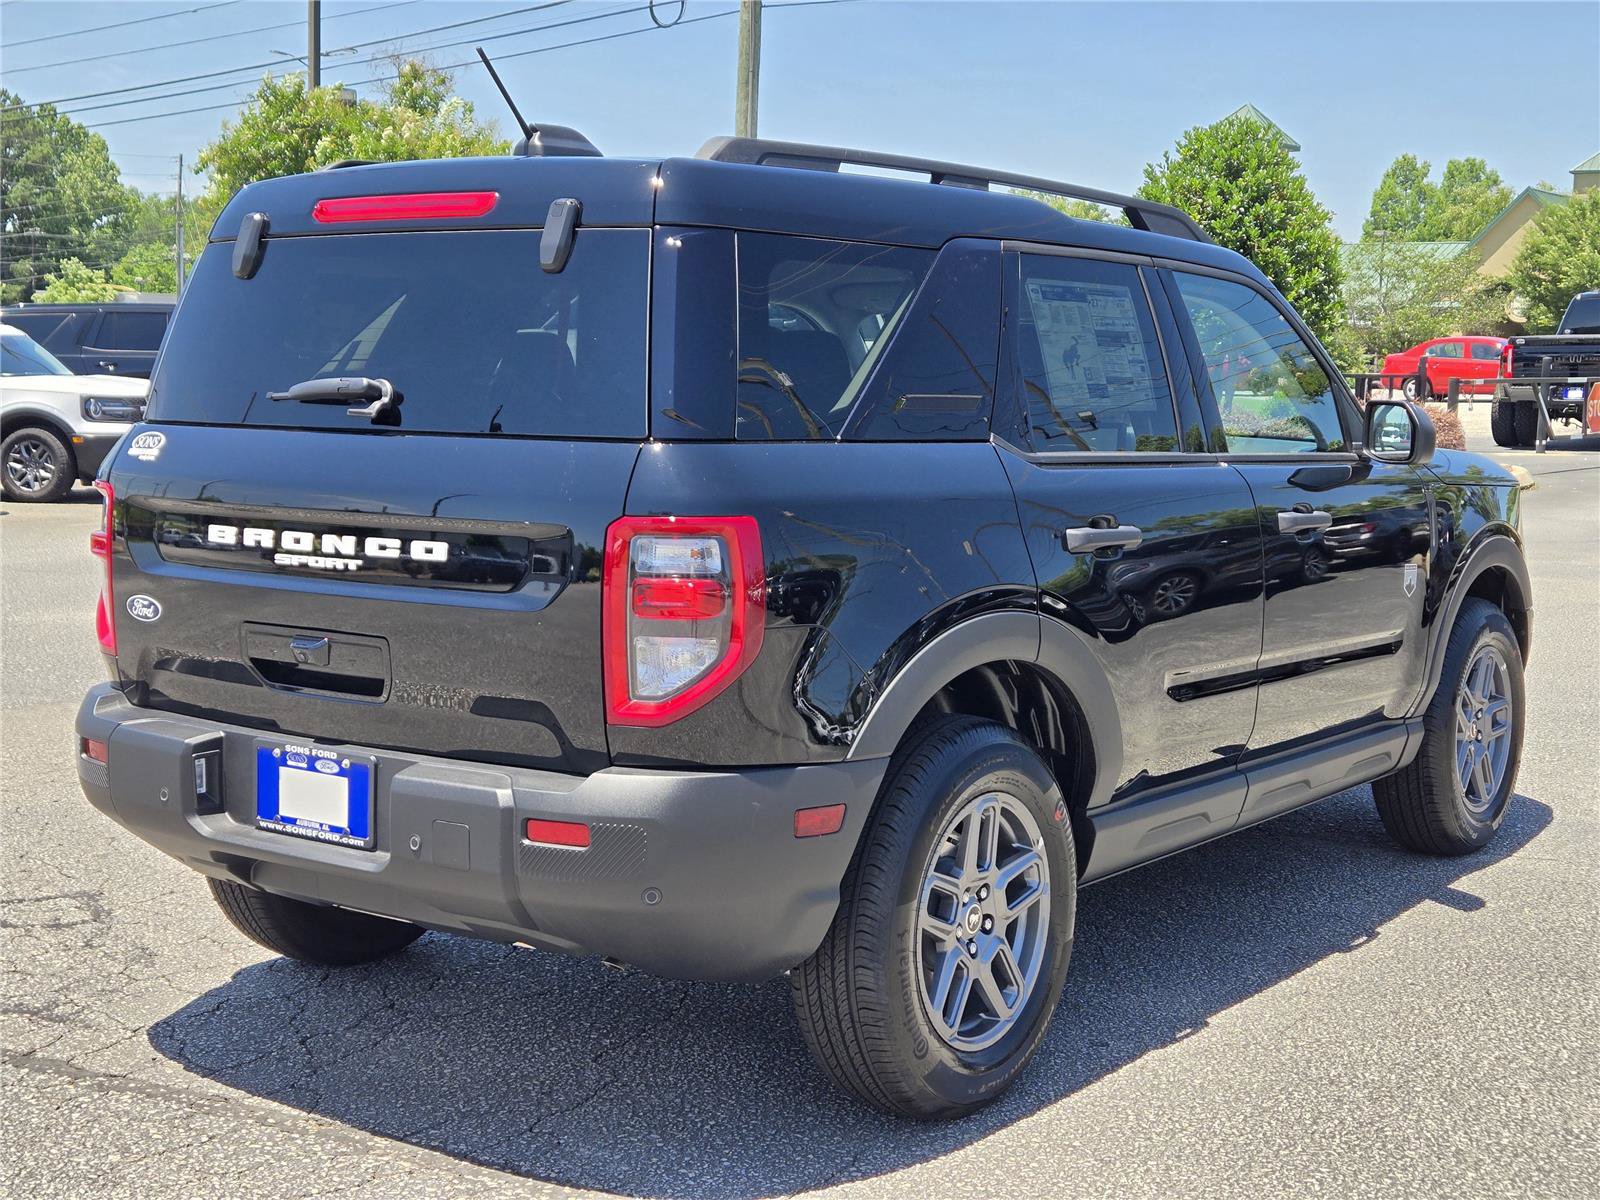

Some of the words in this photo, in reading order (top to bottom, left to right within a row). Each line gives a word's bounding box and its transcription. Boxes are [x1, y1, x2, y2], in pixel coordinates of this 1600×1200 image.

[207, 524, 449, 563] BRONCO
[273, 552, 364, 571] SPORT
[130, 597, 157, 619] Ford
[285, 744, 310, 755] SONS
[311, 749, 337, 759] FORD
[259, 820, 364, 846] www.SONSFORD.com
